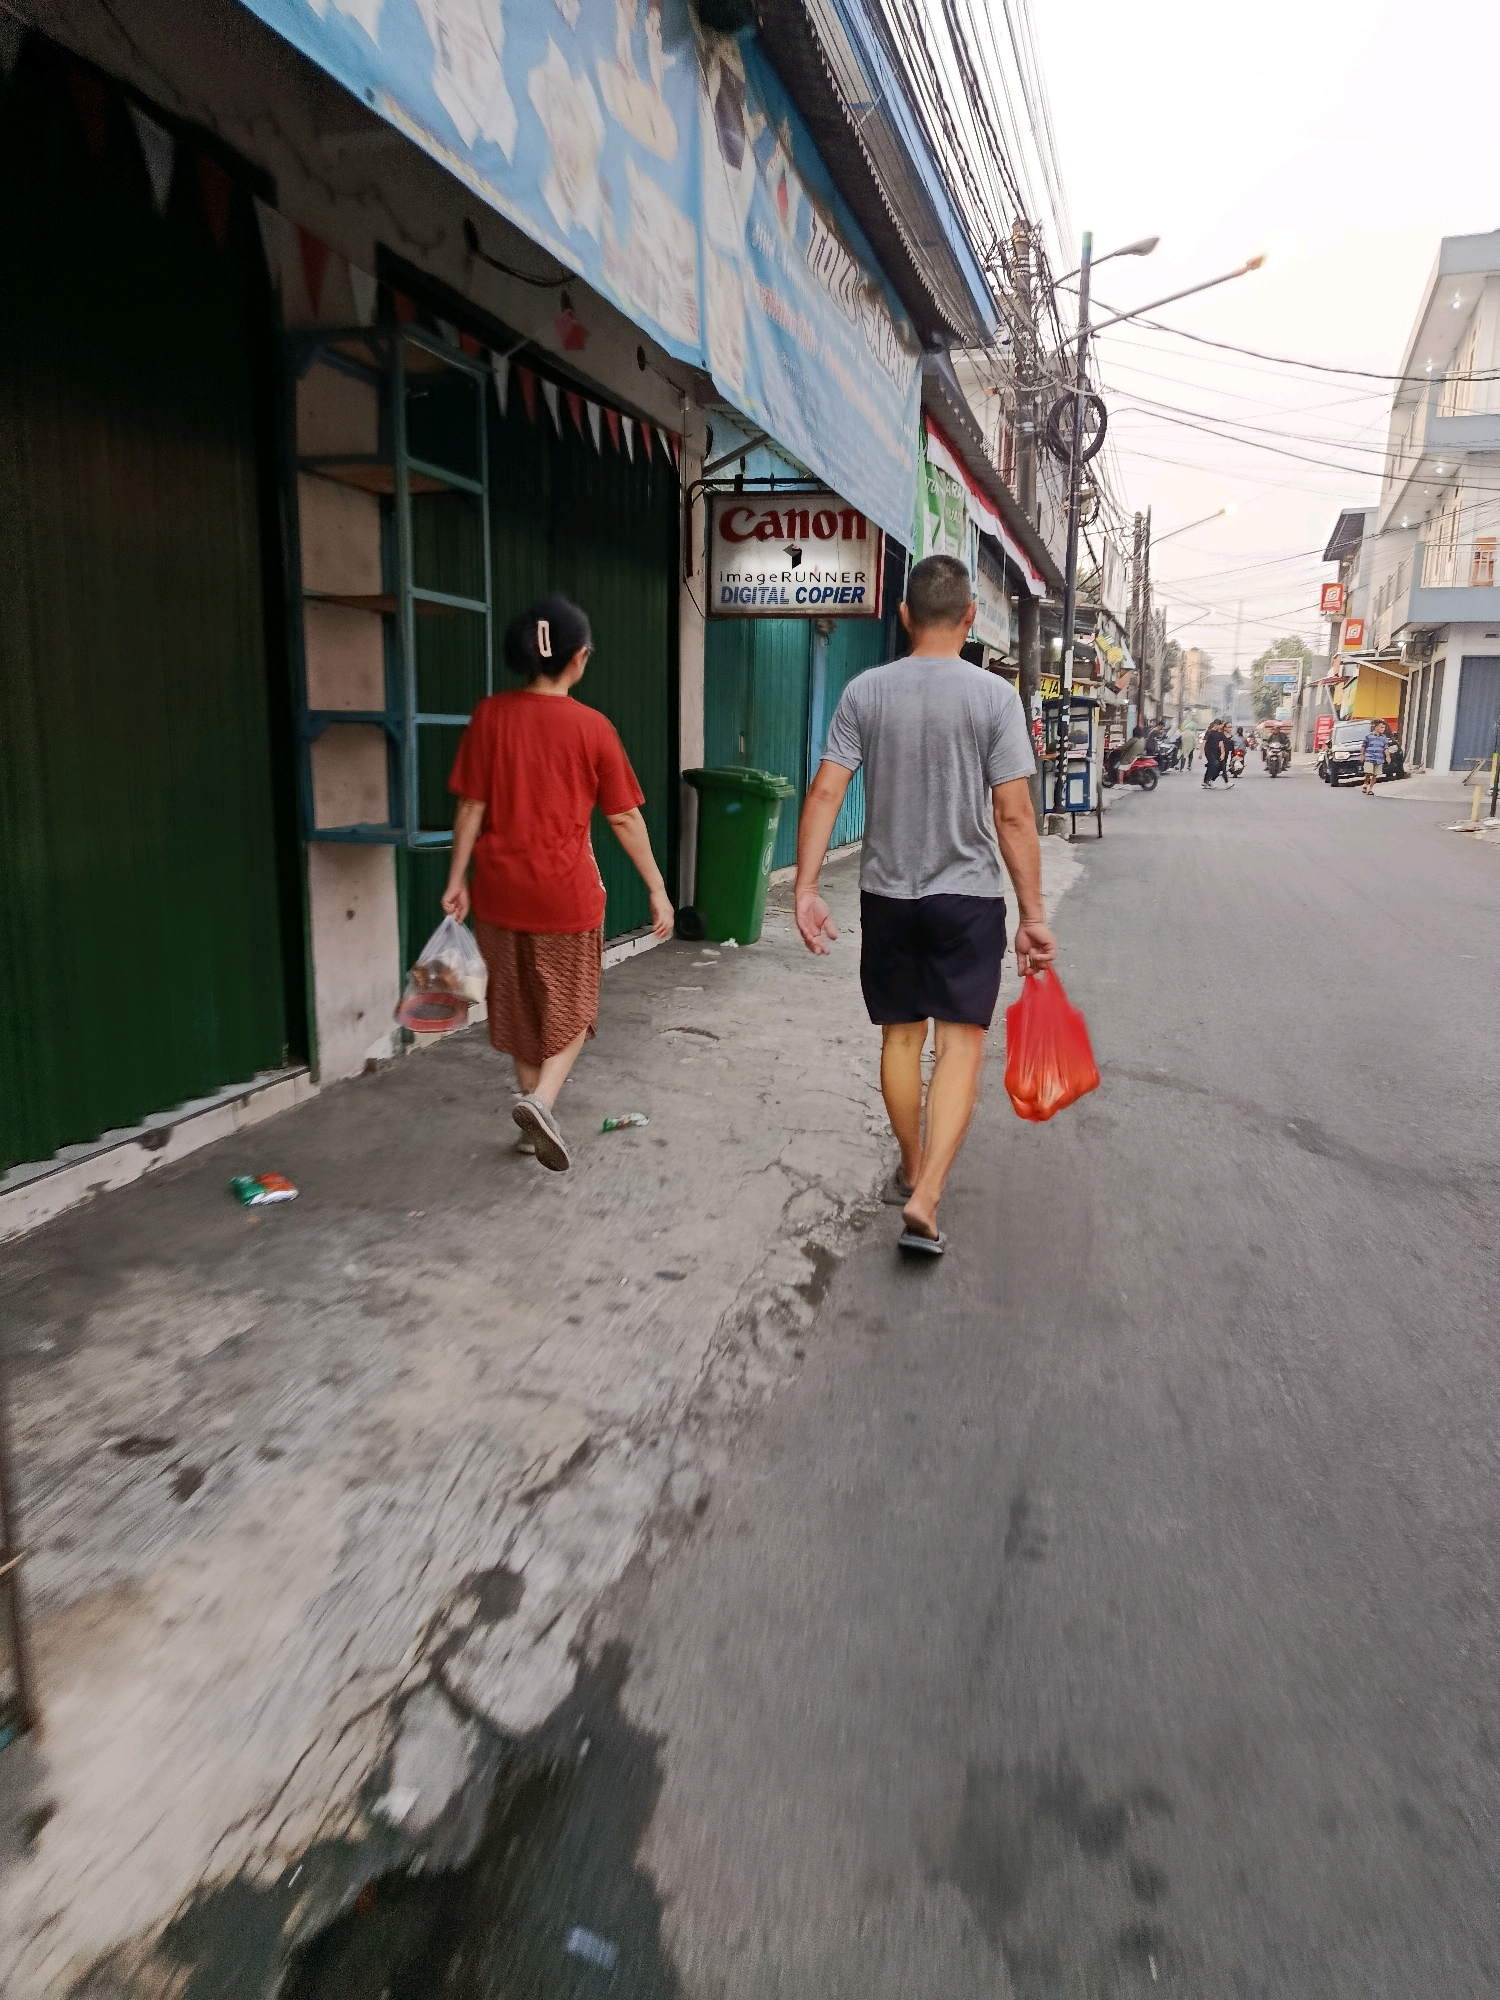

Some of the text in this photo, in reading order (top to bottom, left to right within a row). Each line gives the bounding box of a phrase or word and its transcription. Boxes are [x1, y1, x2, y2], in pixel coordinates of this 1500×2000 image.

[719, 506, 867, 543] Canon
[720, 571, 866, 585] imageRUNNER
[720, 586, 866, 604] DIGITAL COPIER
